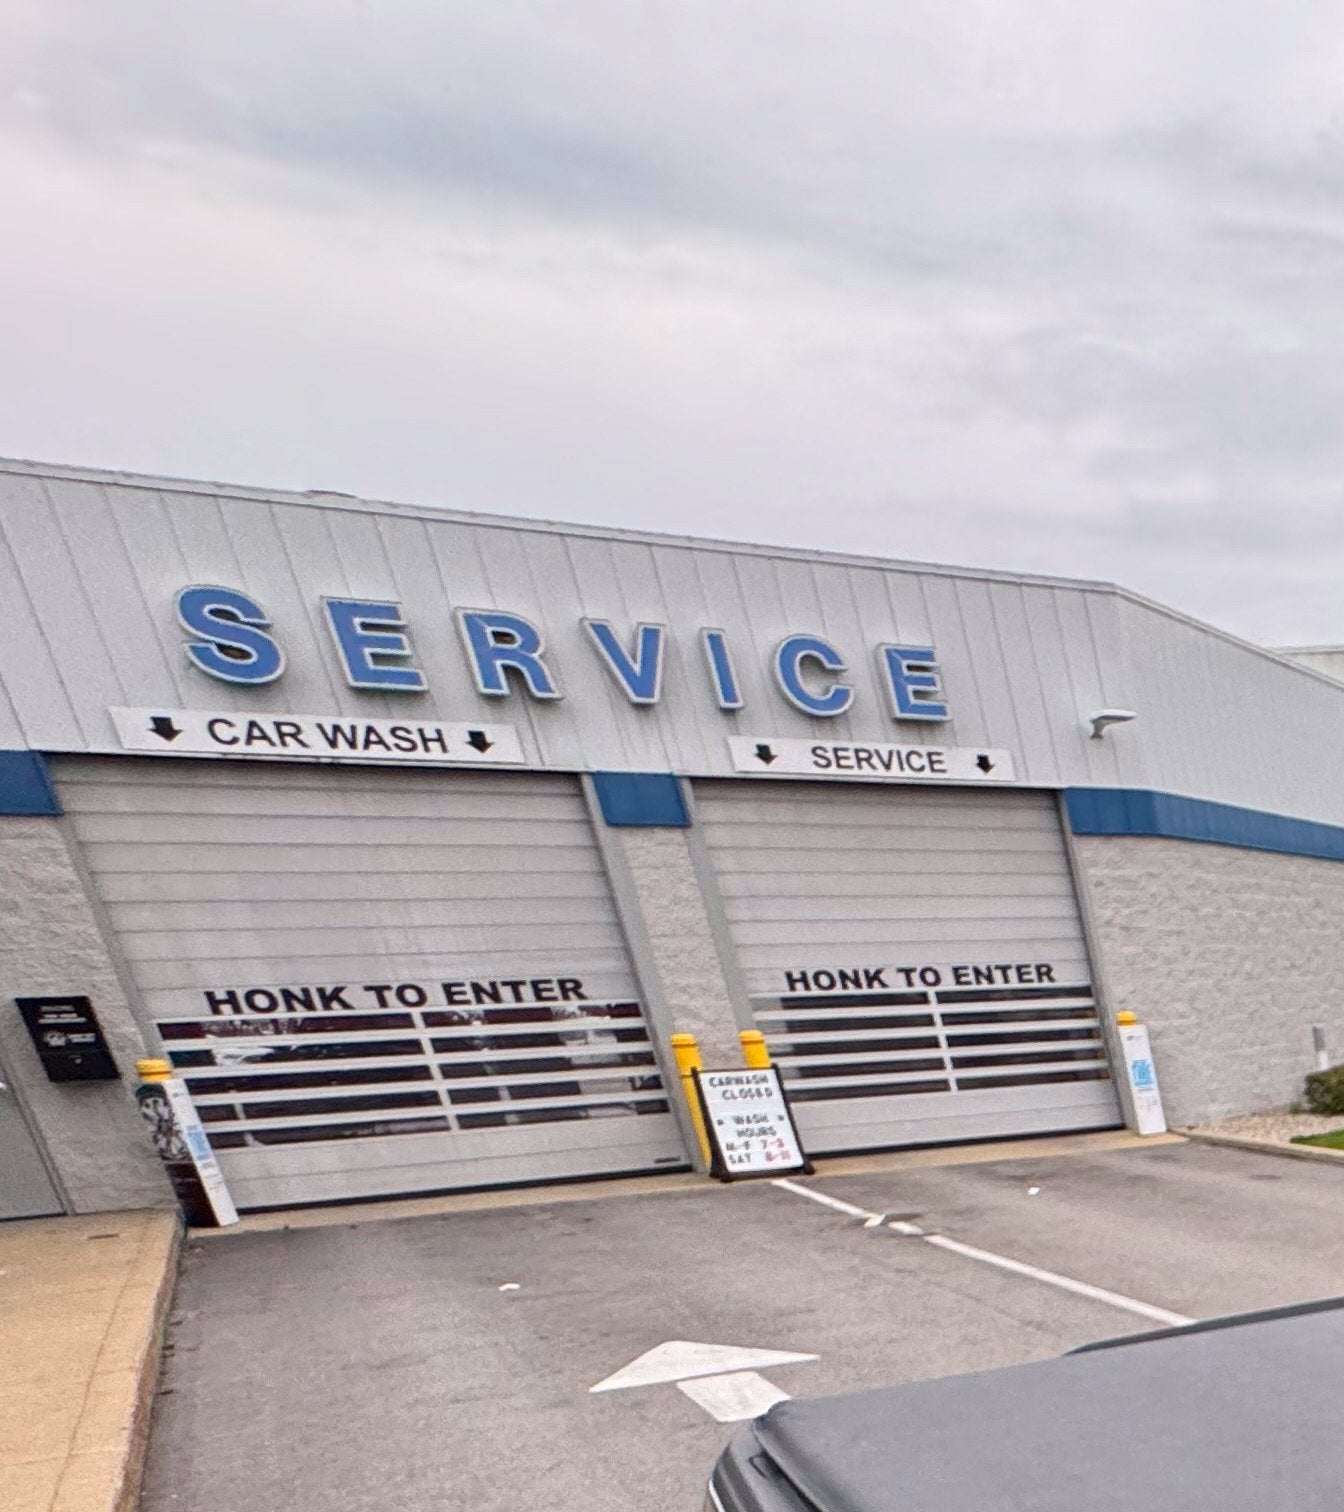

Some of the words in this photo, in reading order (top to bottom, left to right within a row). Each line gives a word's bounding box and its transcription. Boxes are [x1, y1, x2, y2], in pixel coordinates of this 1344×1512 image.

[174, 584, 952, 722] SERVICE
[207, 718, 311, 749] CAR
[316, 722, 450, 754] WASH
[810, 745, 948, 774] SERVICE
[785, 967, 889, 991] HONK
[897, 966, 942, 988] TO
[951, 963, 1056, 986] ENTER
[204, 985, 357, 1015] HONK
[364, 983, 428, 1008] TO
[441, 977, 589, 1006] ENTER
[721, 1086, 773, 1101] CLOSED
